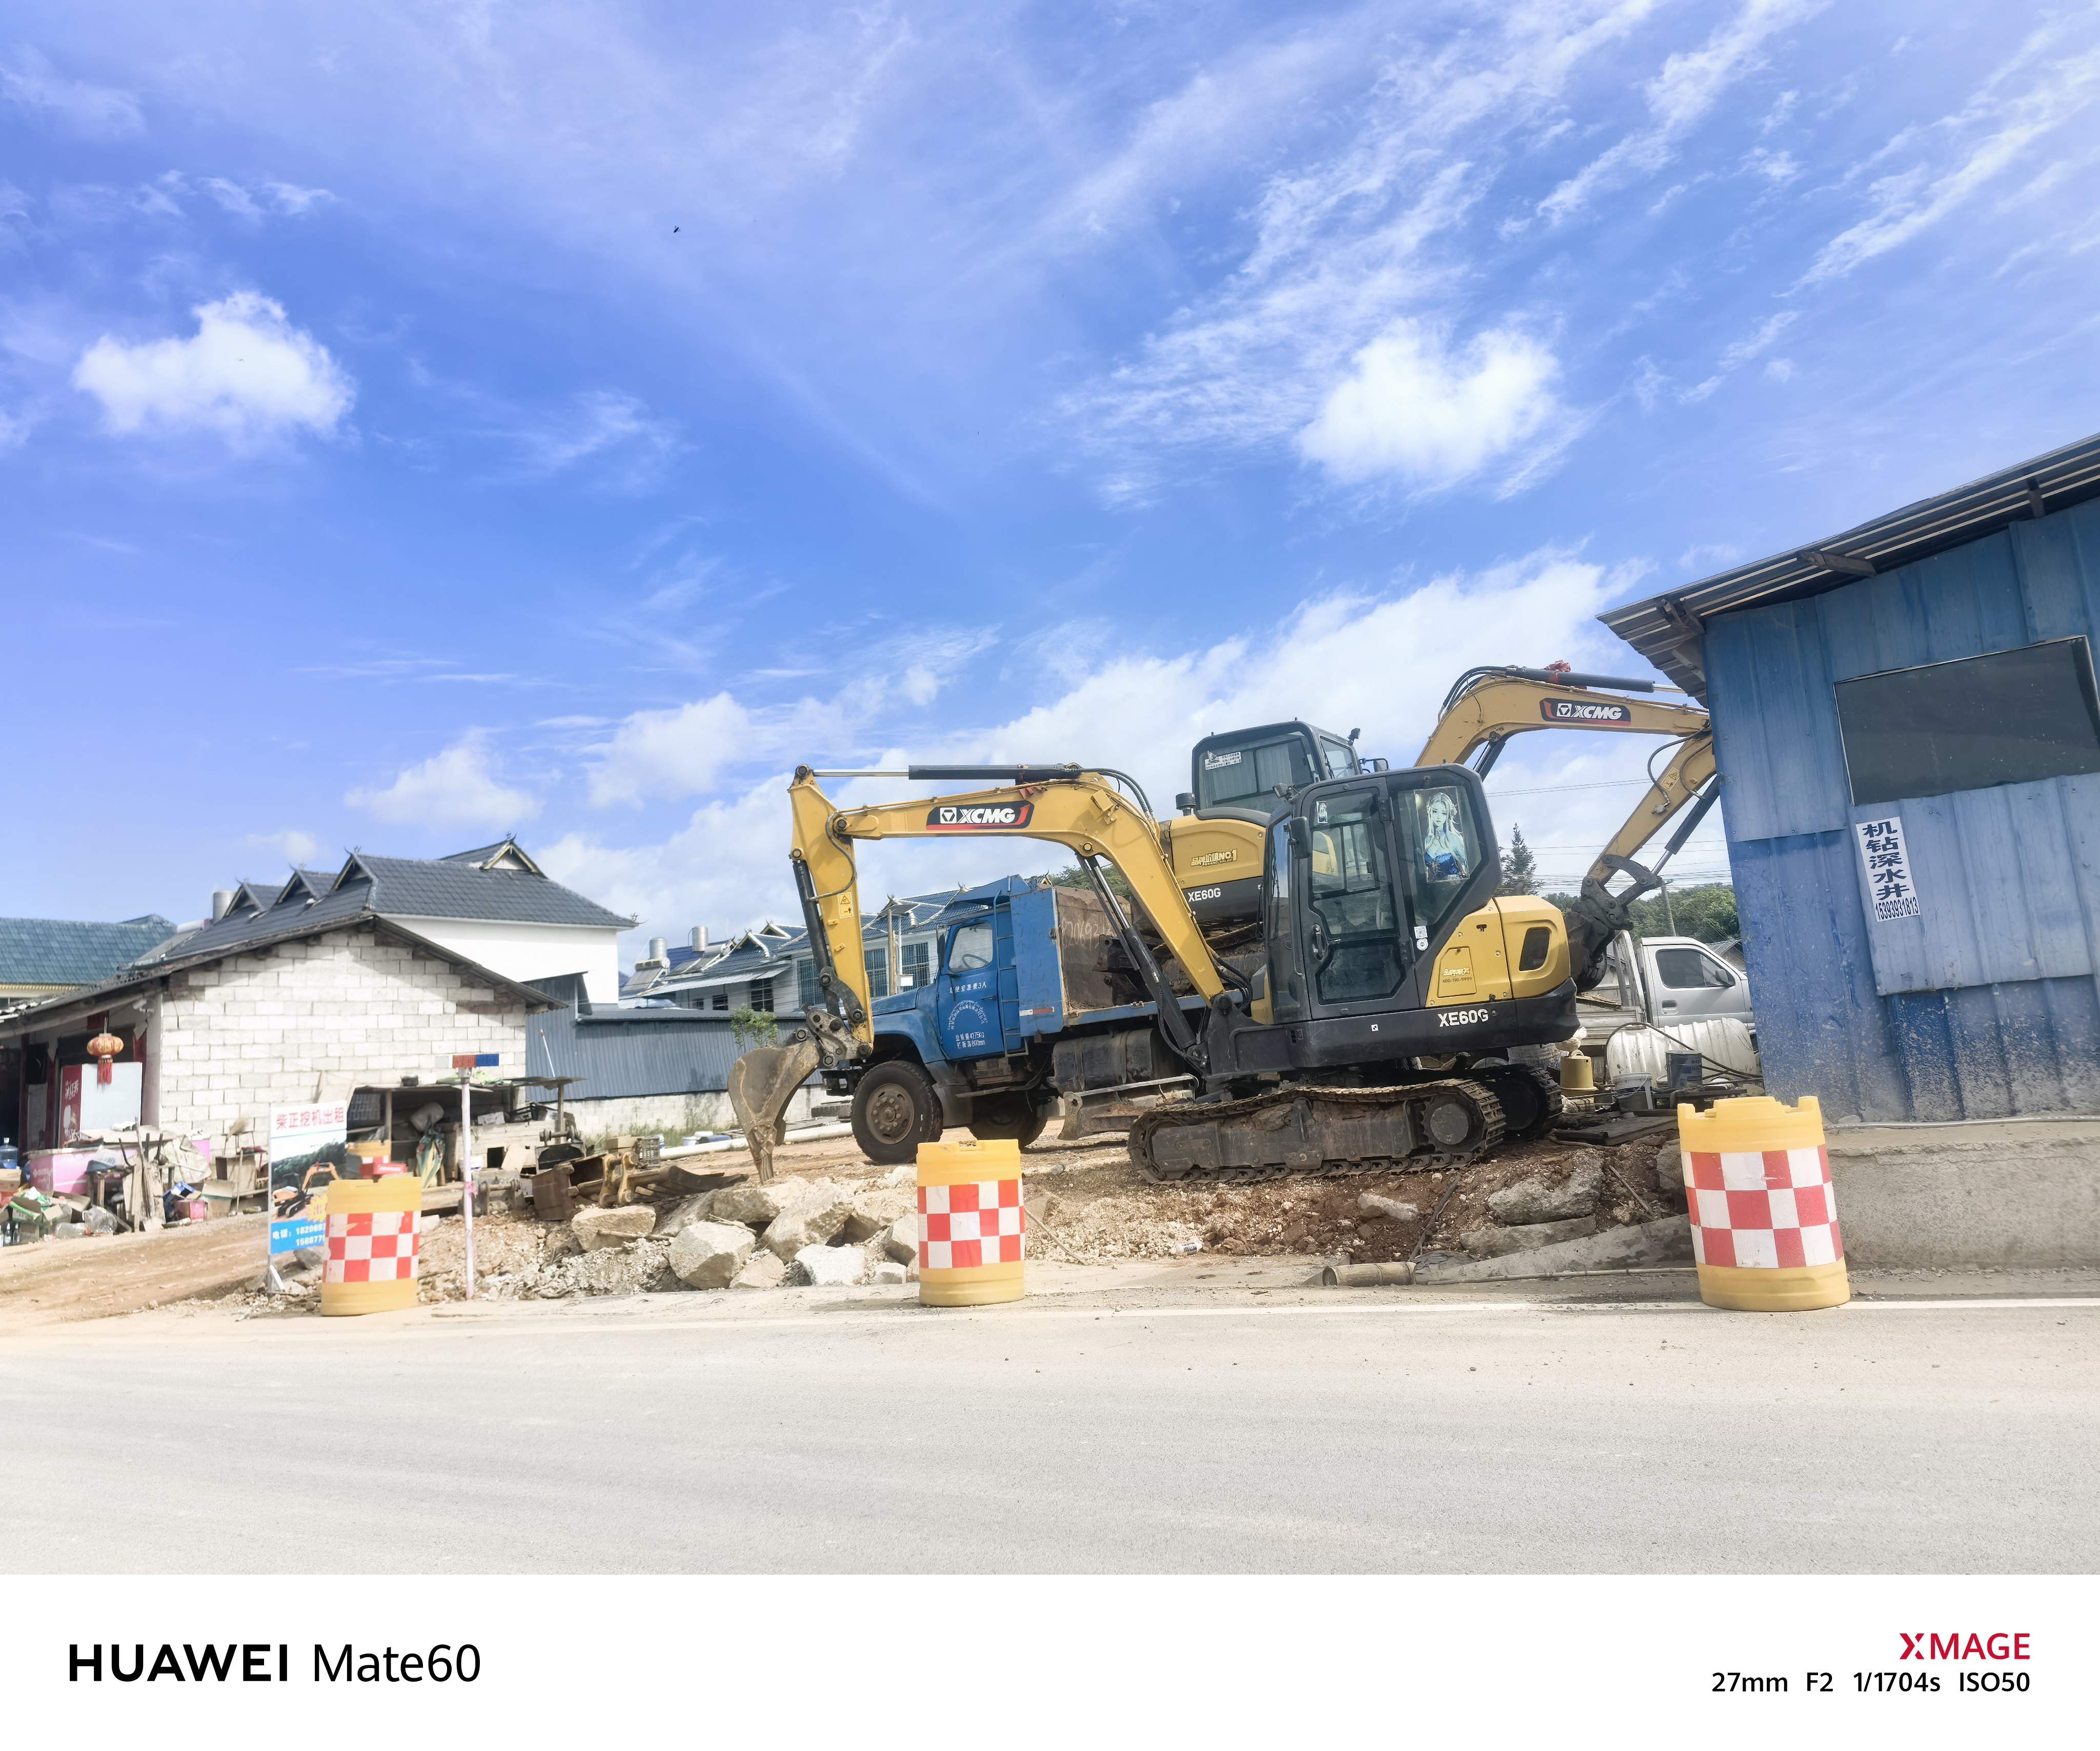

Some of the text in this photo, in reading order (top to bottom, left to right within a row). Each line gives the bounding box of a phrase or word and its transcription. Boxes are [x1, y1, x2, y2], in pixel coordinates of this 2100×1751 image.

[1570, 705, 1622, 720] XCMG
[957, 808, 1016, 824] XCMG
[1863, 821, 1910, 901] 机钻深水井
[1187, 887, 1221, 902] XE60G
[1875, 897, 1919, 921] 15393931813
[1437, 1009, 1489, 1027] XE60G
[276, 1107, 344, 1130] 柴正挖机出租
